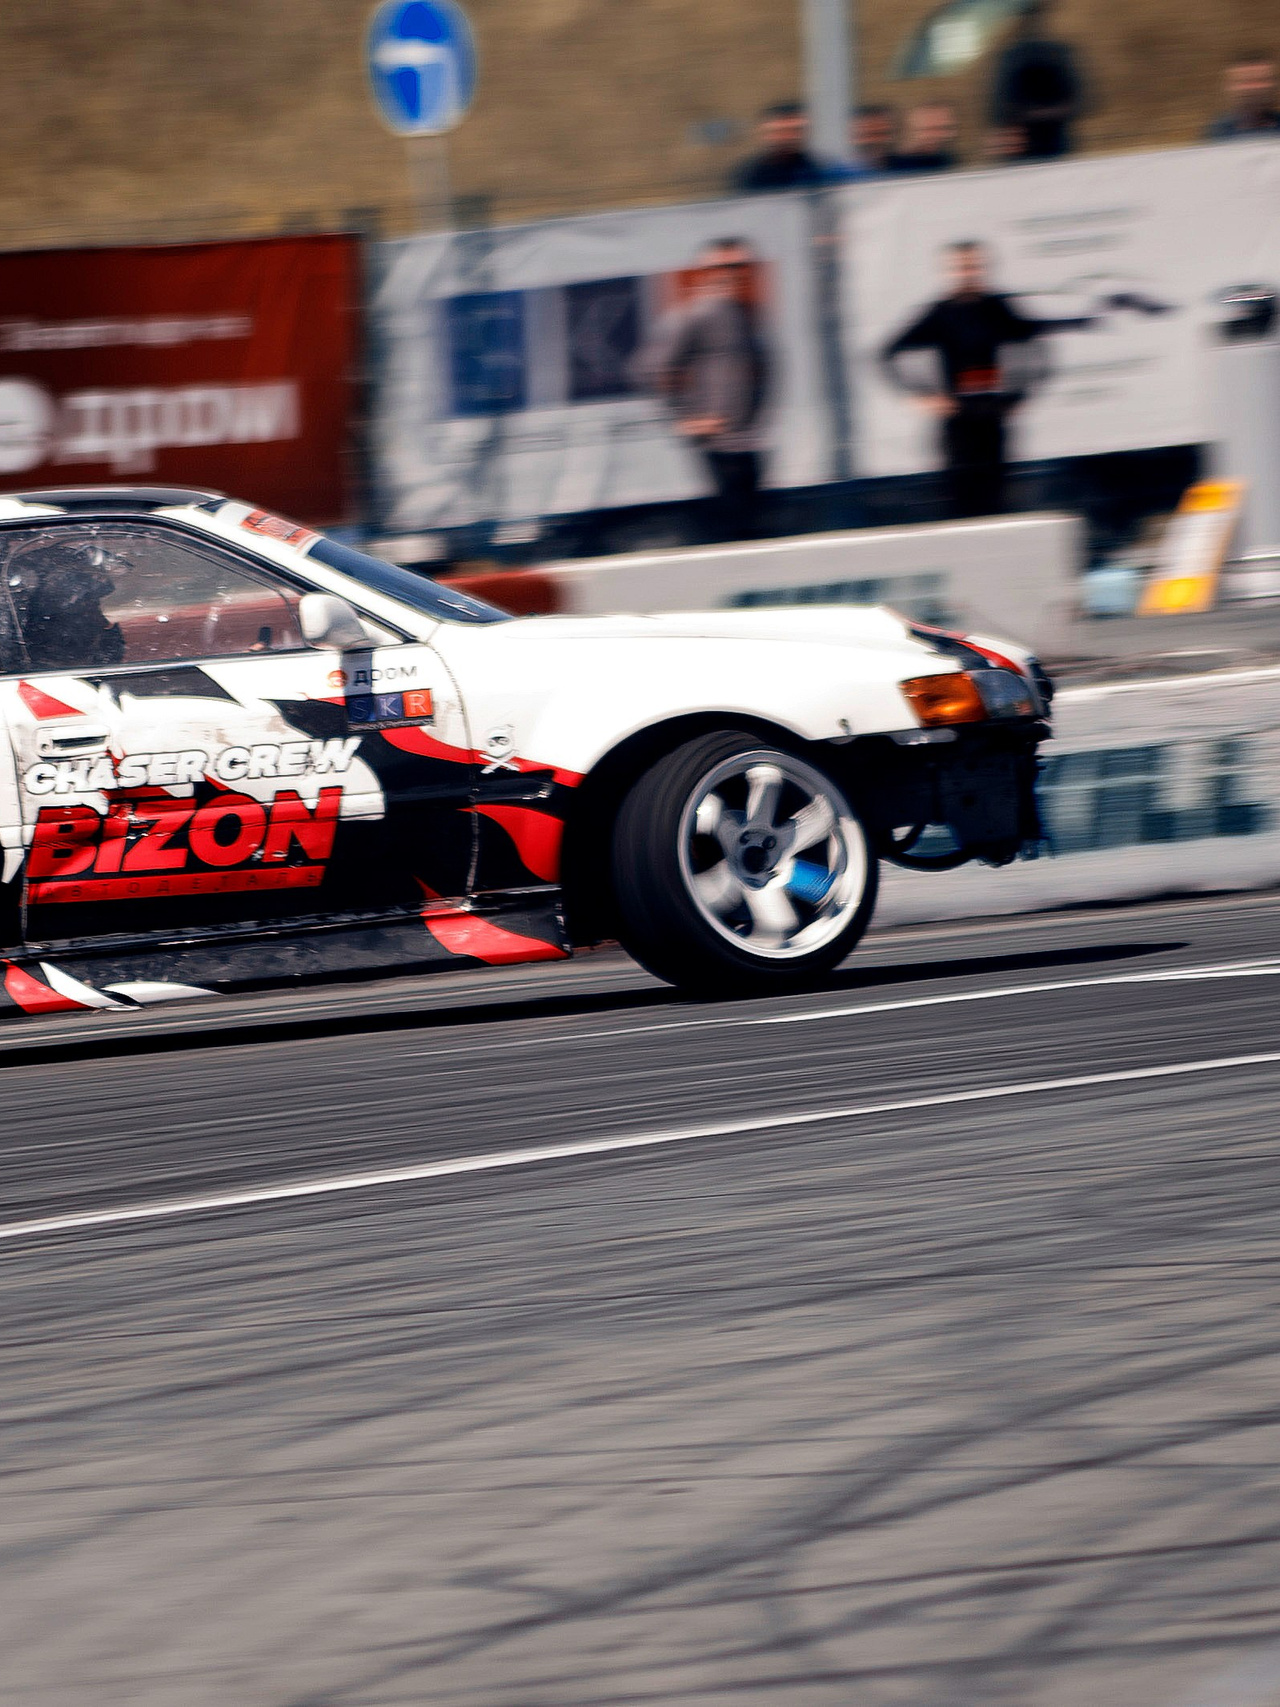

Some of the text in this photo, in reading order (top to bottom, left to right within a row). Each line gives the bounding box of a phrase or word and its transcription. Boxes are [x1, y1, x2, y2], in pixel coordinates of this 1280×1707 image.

[23, 735, 364, 795] CHASER CREW
[25, 785, 343, 878] BIZON
